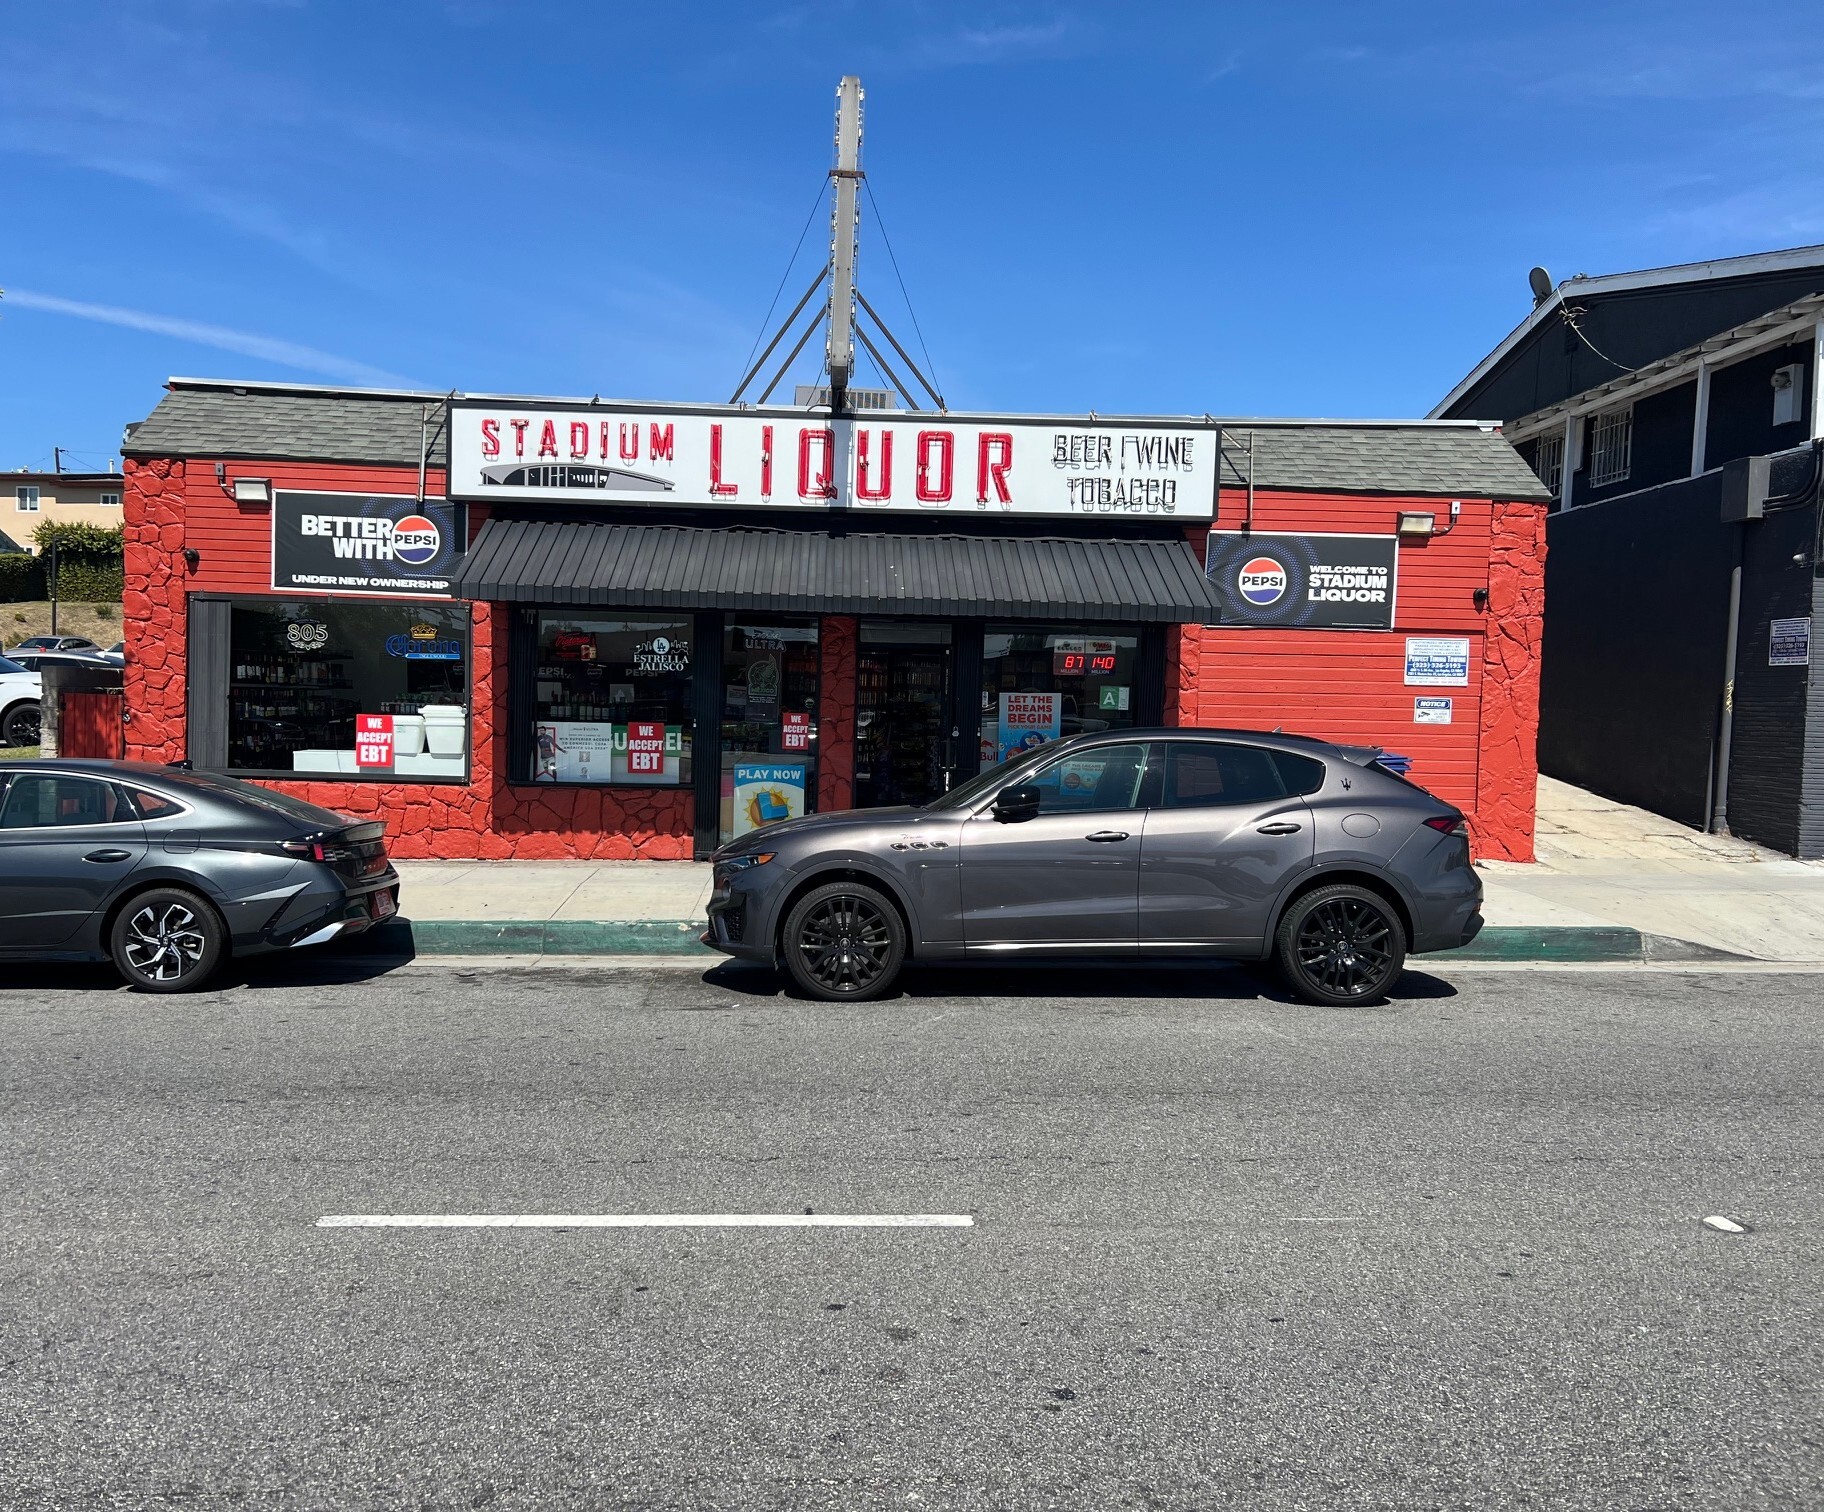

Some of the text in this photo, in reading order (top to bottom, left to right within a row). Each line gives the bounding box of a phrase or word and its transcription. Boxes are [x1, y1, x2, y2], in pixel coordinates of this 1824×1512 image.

[481, 418, 674, 462] STADIUM
[1053, 435, 1195, 464] BEER WINE
[709, 424, 1014, 504] LIQUOR
[1069, 478, 1176, 506] TOBACCO
[301, 514, 394, 539] BETTER
[394, 534, 437, 546] PEPSI
[332, 537, 394, 560] WITH
[1309, 565, 1388, 575] WELCOME TO
[291, 574, 449, 589] UNDER NEW OWNERSHIP
[1242, 576, 1283, 587] PEPSI
[1308, 574, 1388, 589] STADIUM
[1307, 588, 1386, 603] LIQUOR
[287, 624, 329, 642] 805
[385, 633, 461, 657] Corona
[745, 639, 785, 651] ULTRA
[633, 654, 689, 664] ESTRELLA
[1065, 656, 1084, 669] 87
[1091, 656, 1115, 669] 140
[638, 662, 684, 672] JALISCO
[1008, 695, 1053, 704] LET THE
[1103, 692, 1115, 705] A
[1007, 704, 1053, 713] DREAMS
[367, 717, 383, 729] WE
[790, 715, 802, 723] WE
[1007, 713, 1053, 724] BEGIN
[638, 725, 654, 737] WE
[783, 725, 808, 734] ACCEPT
[357, 731, 393, 744] ACCEPT
[785, 734, 806, 747] EBT
[628, 739, 664, 751] ACCEPT
[360, 744, 389, 763] EBT
[980, 752, 998, 761] Bull
[632, 752, 660, 770] EBT
[738, 769, 801, 780] PLAY NOW
